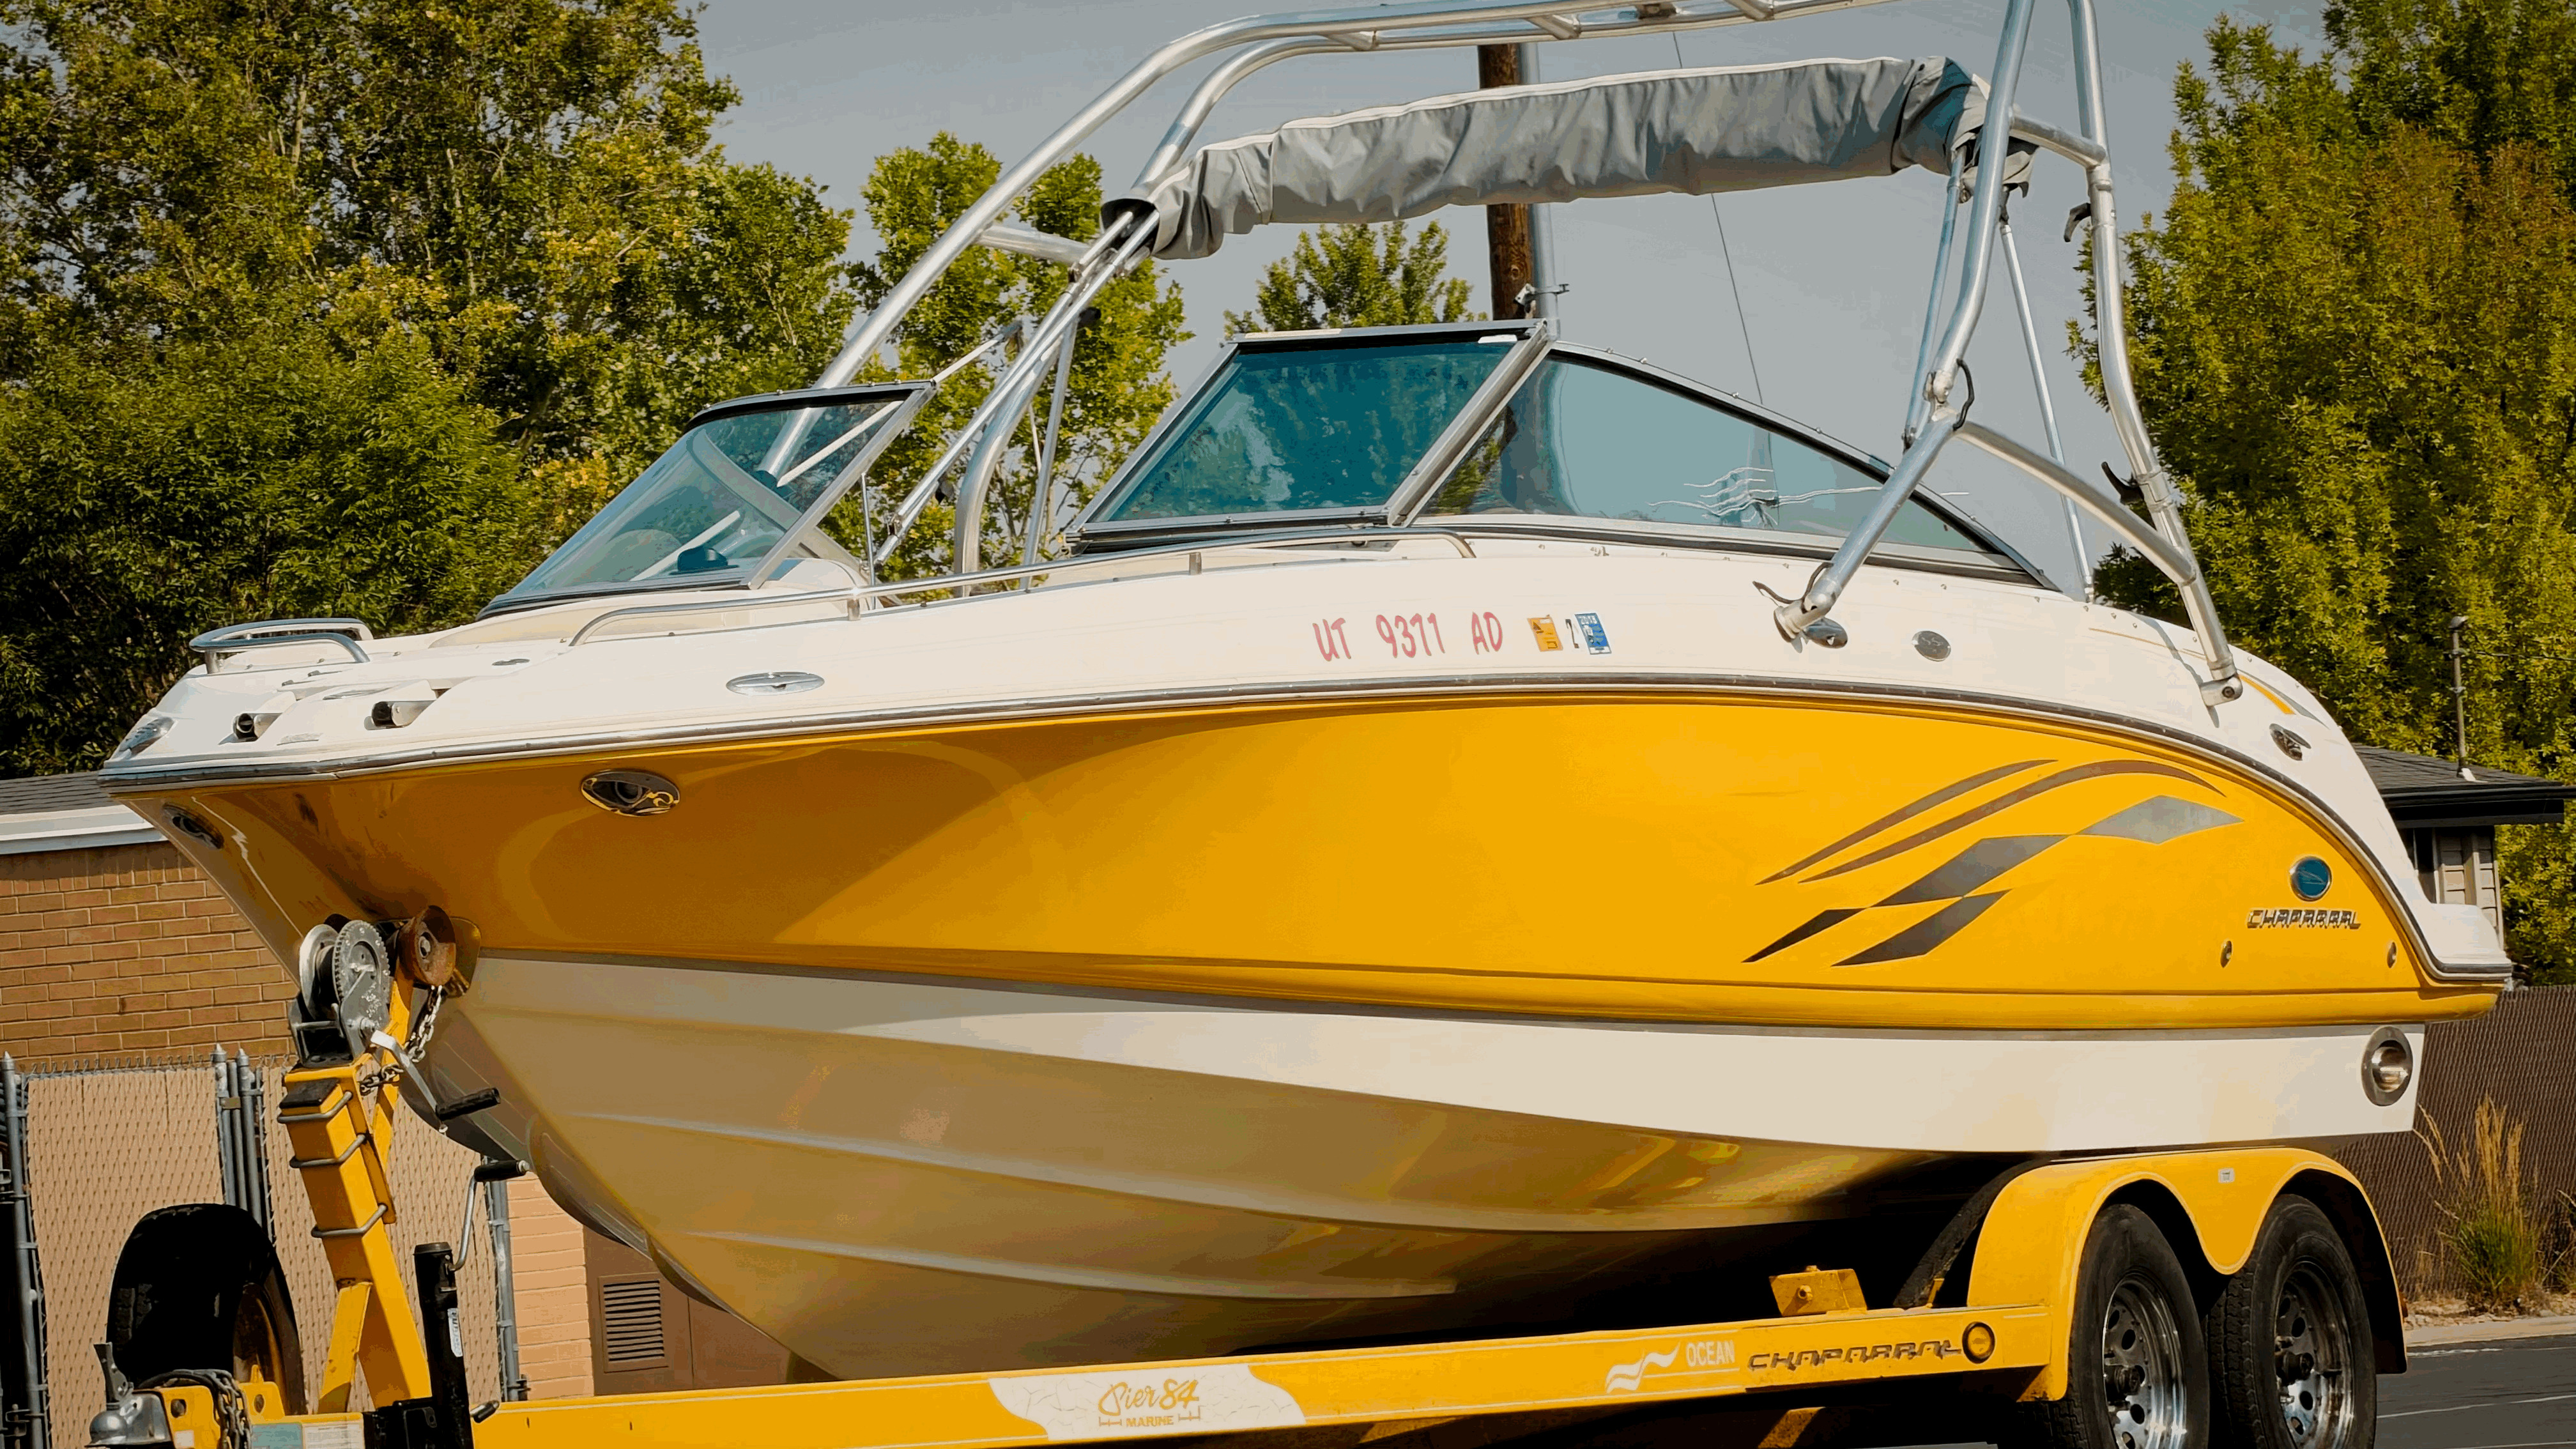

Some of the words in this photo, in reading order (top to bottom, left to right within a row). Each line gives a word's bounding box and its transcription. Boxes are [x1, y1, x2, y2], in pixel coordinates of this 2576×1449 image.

[1312, 618, 1351, 661] UT
[1471, 611, 1503, 655] AD
[2246, 908, 2361, 930] CHAPARRAL
[1685, 1339, 1735, 1367] OCEAN
[1747, 1340, 1962, 1372] CHAPARRAL
[1159, 1378, 1200, 1410] 84
[1126, 1416, 1174, 1427] MARINE
